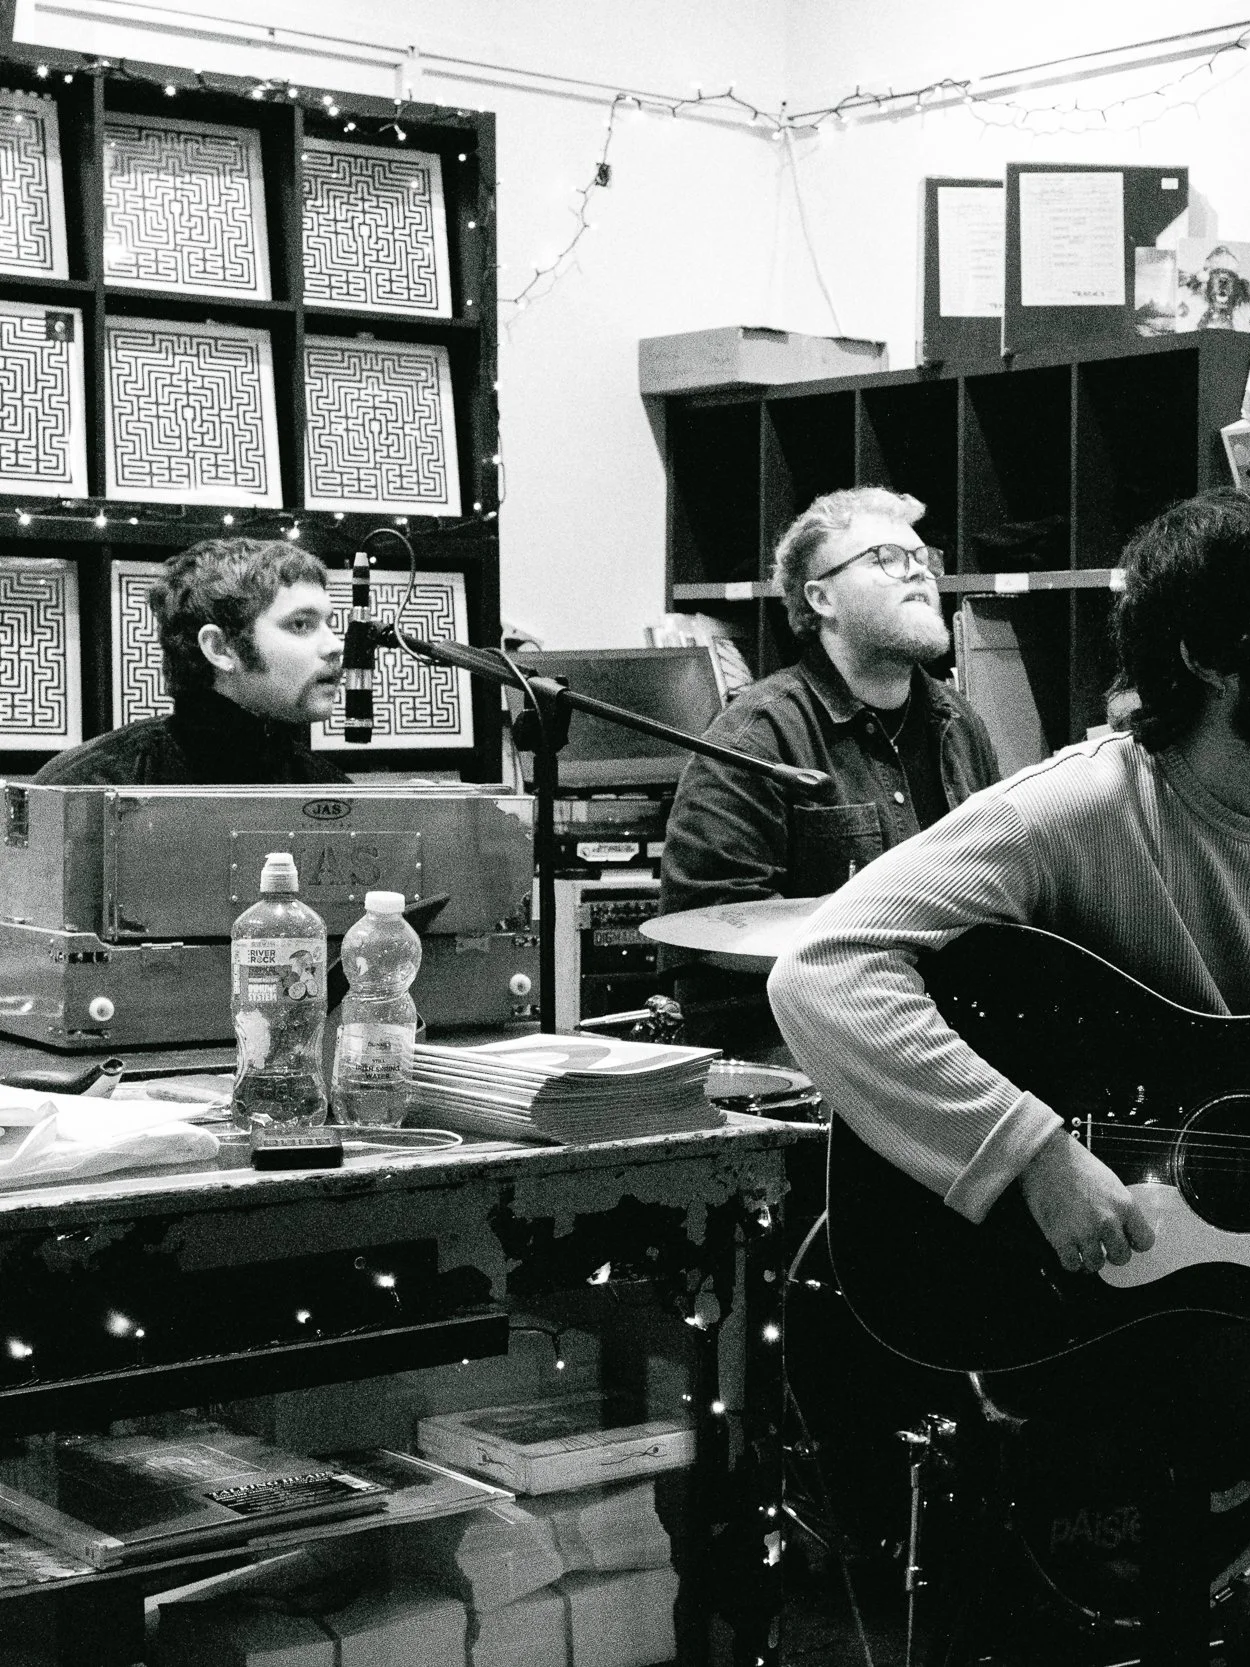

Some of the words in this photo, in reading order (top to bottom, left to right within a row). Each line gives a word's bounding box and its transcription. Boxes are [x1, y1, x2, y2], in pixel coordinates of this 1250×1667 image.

[312, 803, 343, 815] JAS
[250, 949, 276, 957] RIVER
[250, 956, 276, 964] ROCK
[248, 992, 278, 1002] SYSTEM
